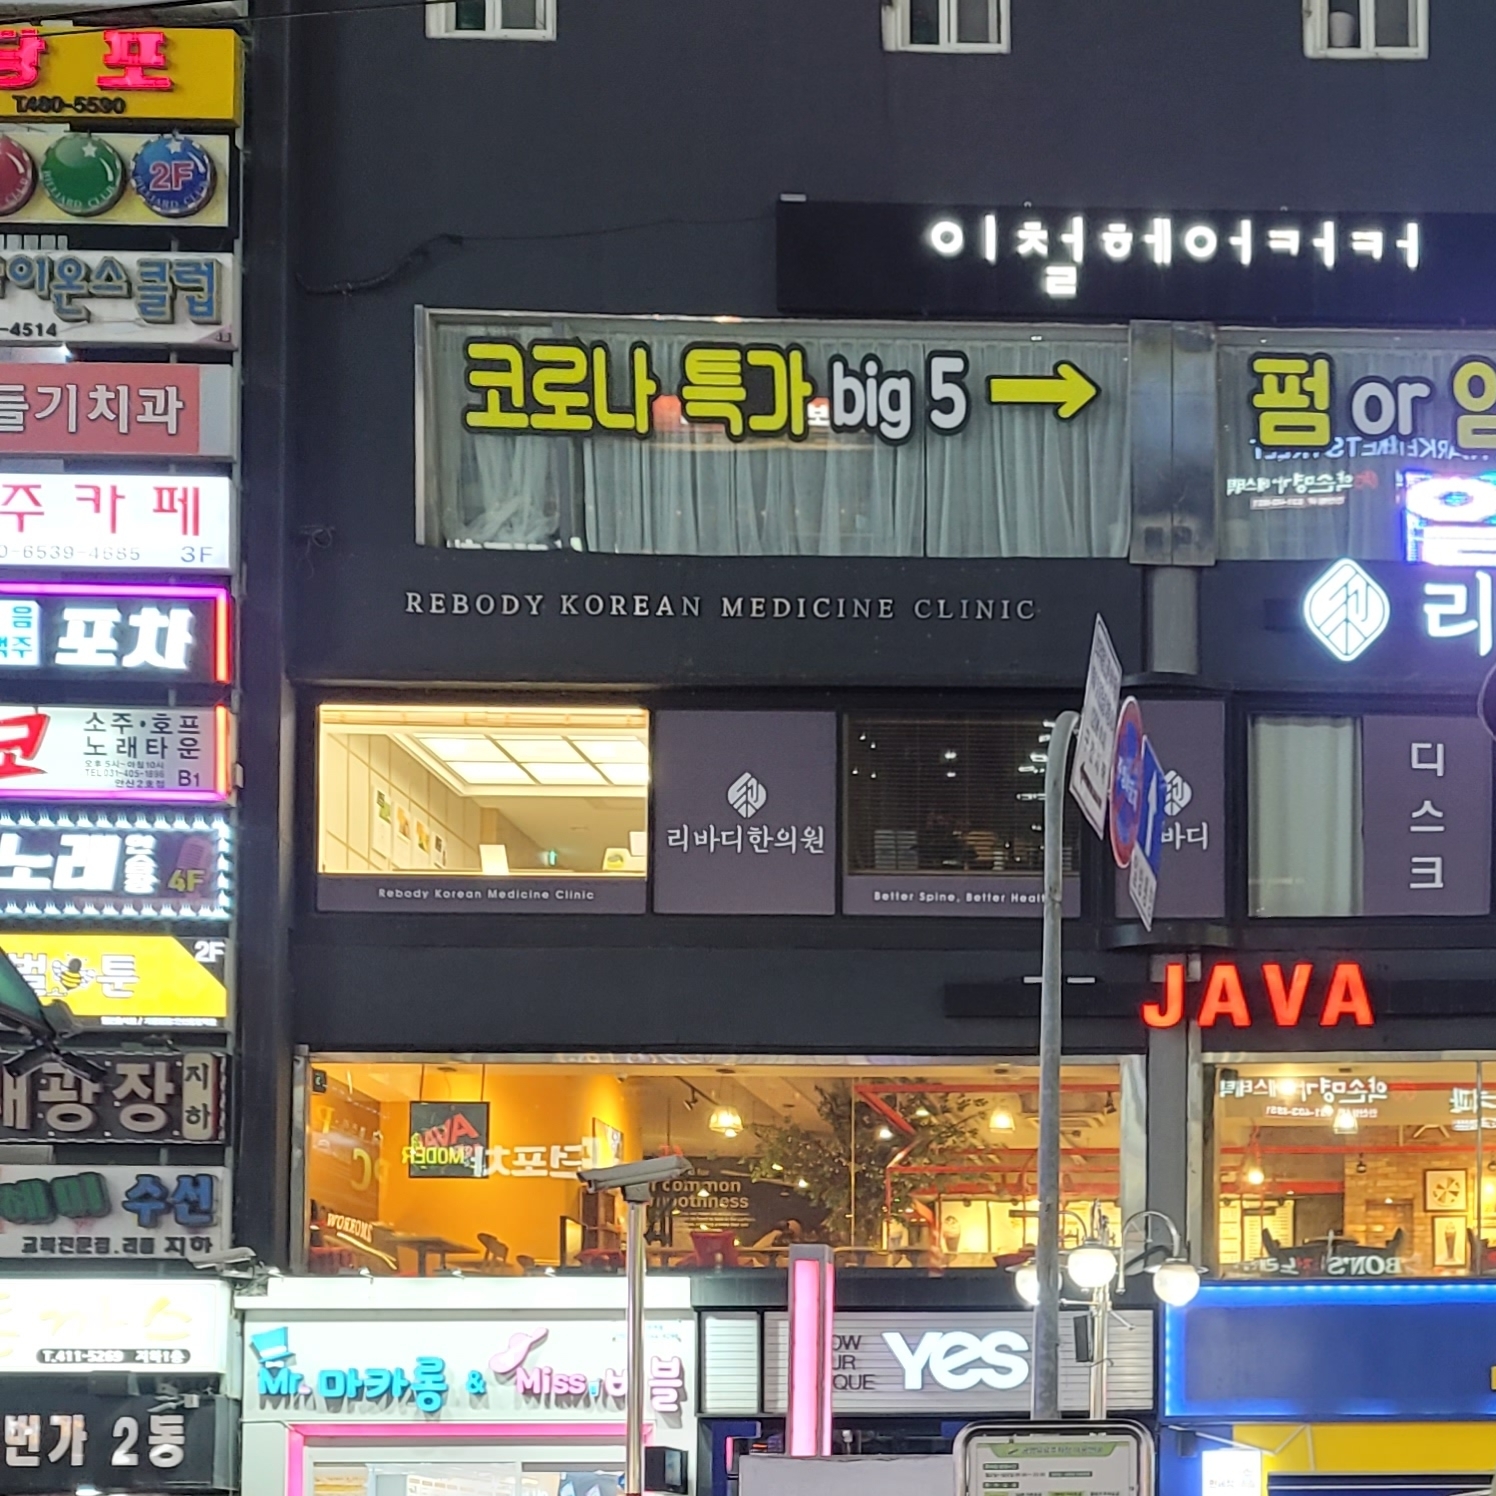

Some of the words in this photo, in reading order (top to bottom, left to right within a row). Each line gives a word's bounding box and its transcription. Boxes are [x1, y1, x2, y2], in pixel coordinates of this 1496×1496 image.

[149, 161, 194, 191] 2F
[929, 214, 1421, 297] 이철헤어커커
[0, 255, 221, 324] 이온스클럽
[463, 341, 659, 438] 코로나
[680, 341, 814, 440] 특가
[830, 354, 912, 443] big
[926, 354, 967, 432] 5
[1250, 355, 1332, 449] 펌
[1350, 376, 1432, 437] or
[180, 546, 214, 564] 3F
[405, 591, 545, 617] REBODY
[560, 593, 703, 619] KOREAN
[720, 596, 895, 620] MEDICINE
[913, 599, 1037, 621] CLINIC
[53, 605, 198, 671] 포차
[83, 736, 201, 760] 노래타운
[85, 769, 102, 778] TEL
[178, 769, 201, 788] B1
[1409, 741, 1446, 890] 디스크
[666, 822, 826, 856] 리바디한의원
[0, 832, 122, 893] 노래
[168, 868, 207, 893] 4F
[378, 887, 430, 902] Rebody
[434, 887, 483, 902] Korean
[487, 887, 551, 902] Medicine
[554, 887, 596, 902] Clinic
[873, 890, 914, 903] Better
[966, 891, 1006, 904] Better
[1011, 892, 1045, 904] Healt
[194, 940, 225, 964] 2F
[1141, 962, 1374, 1028] JAVA
[184, 1064, 210, 1130] 지하
[122, 1173, 217, 1228] 수선
[164, 1235, 214, 1258] 지하
[317, 1356, 449, 1414] 마카롱
[464, 1369, 486, 1395] &
[3, 1413, 89, 1468] 번가
[111, 1414, 186, 1469] 2동
